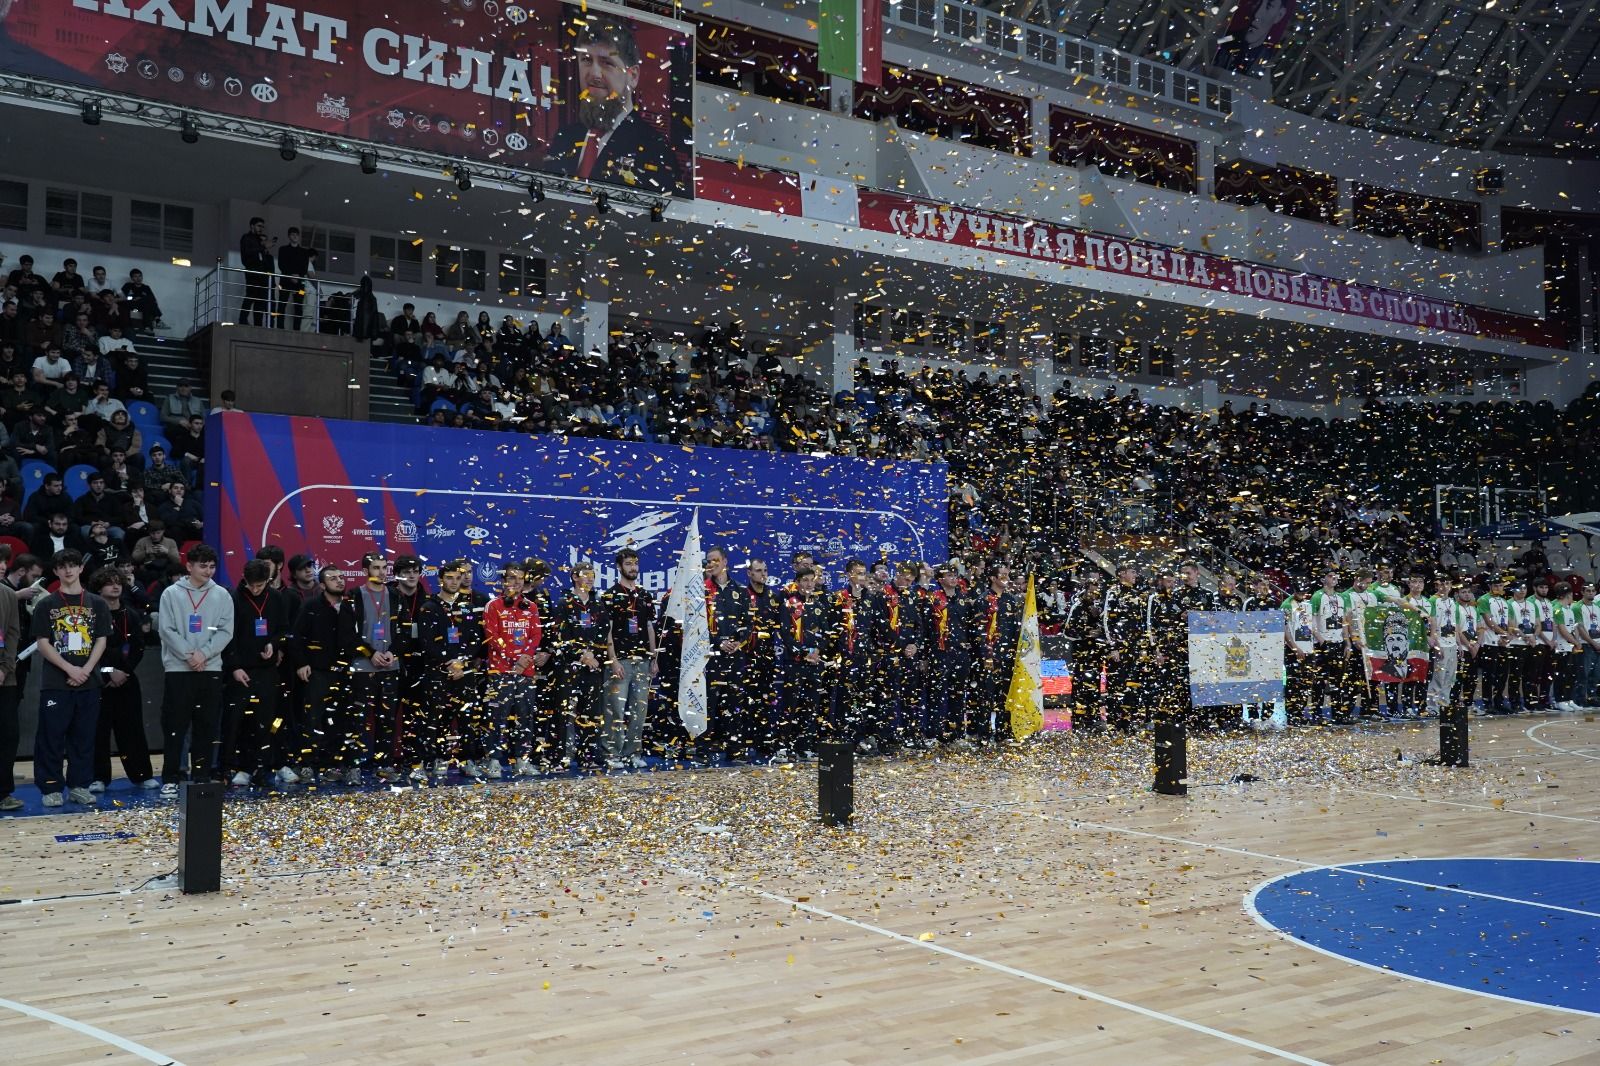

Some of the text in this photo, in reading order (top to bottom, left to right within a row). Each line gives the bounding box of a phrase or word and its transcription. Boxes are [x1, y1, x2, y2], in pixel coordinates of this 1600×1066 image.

[73, 0, 552, 108] ХМАТ СИЛА!
[1083, 236, 1211, 286] ПОБЕДА
[1232, 265, 1344, 309] ПОБЕДА
[1350, 287, 1365, 313] В
